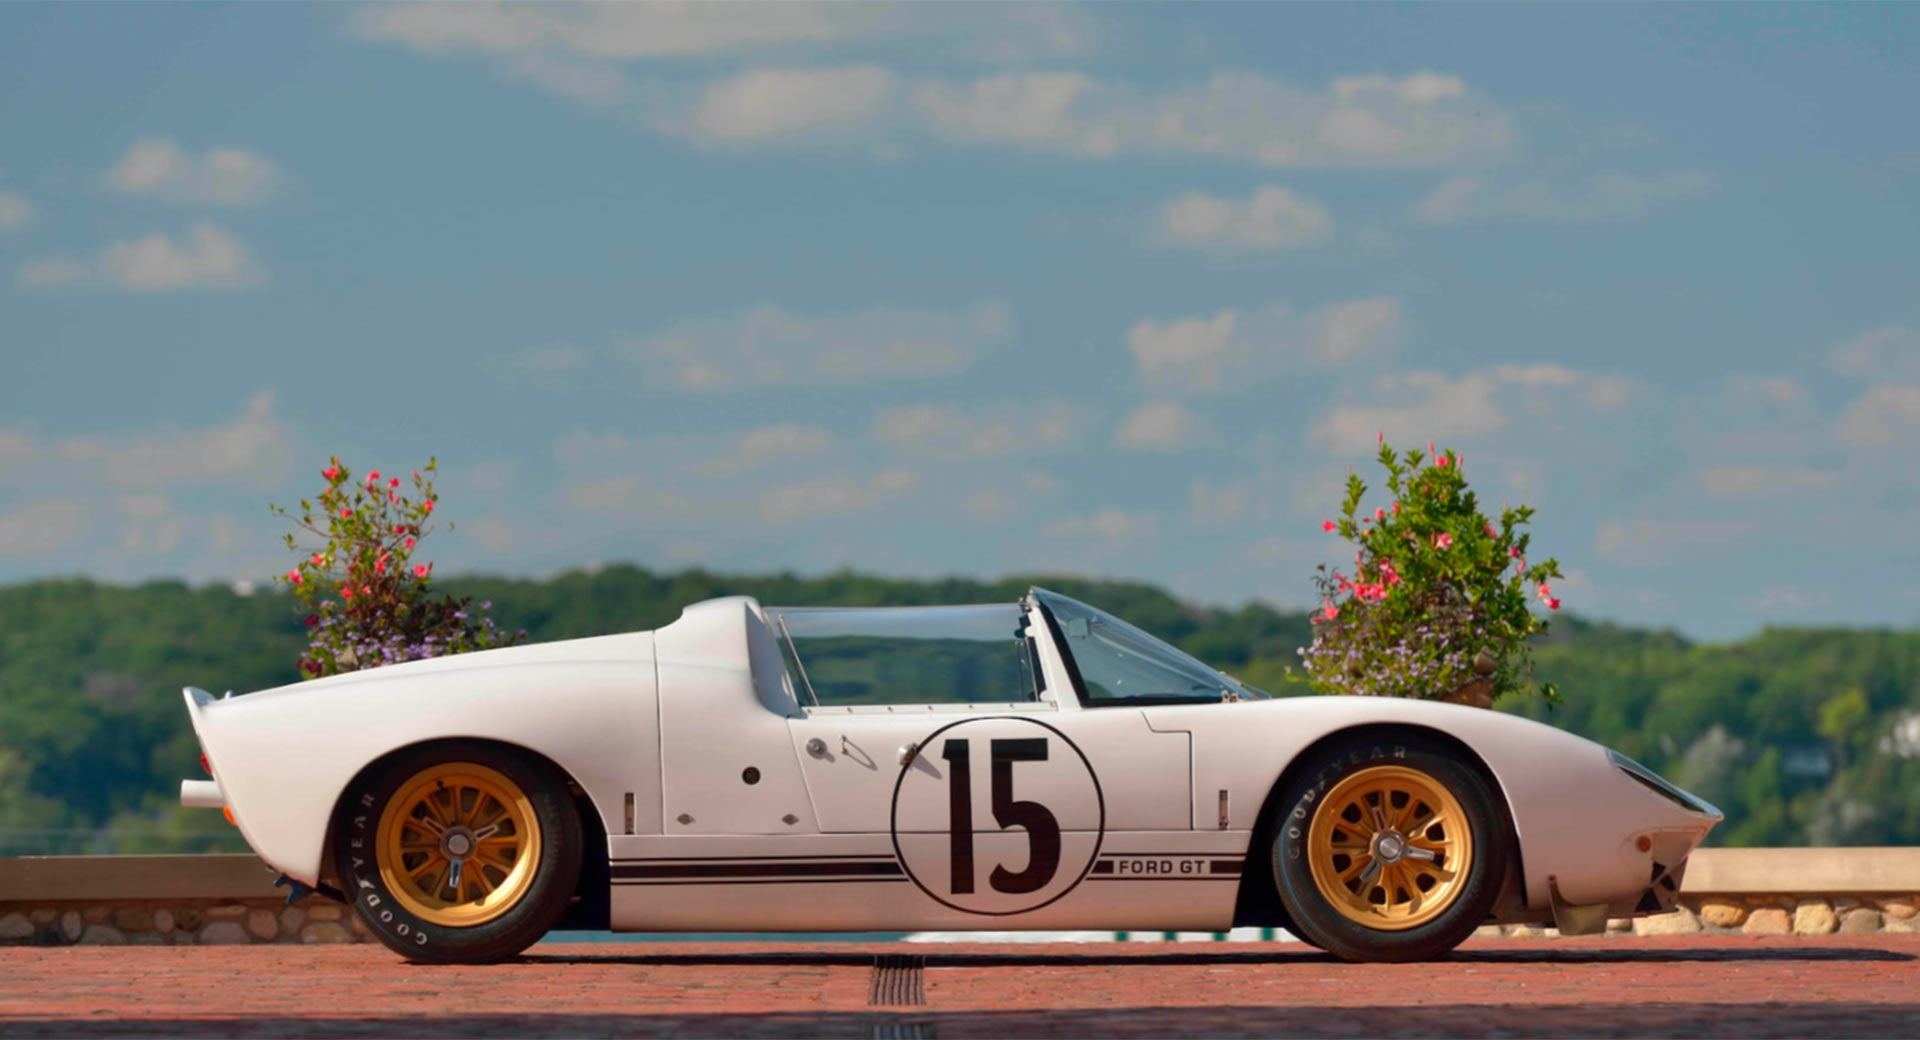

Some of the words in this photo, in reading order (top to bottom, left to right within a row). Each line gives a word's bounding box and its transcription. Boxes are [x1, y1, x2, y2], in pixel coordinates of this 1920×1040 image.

[943, 738, 1061, 894] 15
[1119, 860, 1173, 874] FORD
[1180, 860, 1205, 874] GT
[1287, 746, 1406, 859] GOODYEAR
[351, 793, 428, 945] GOODYEAR
